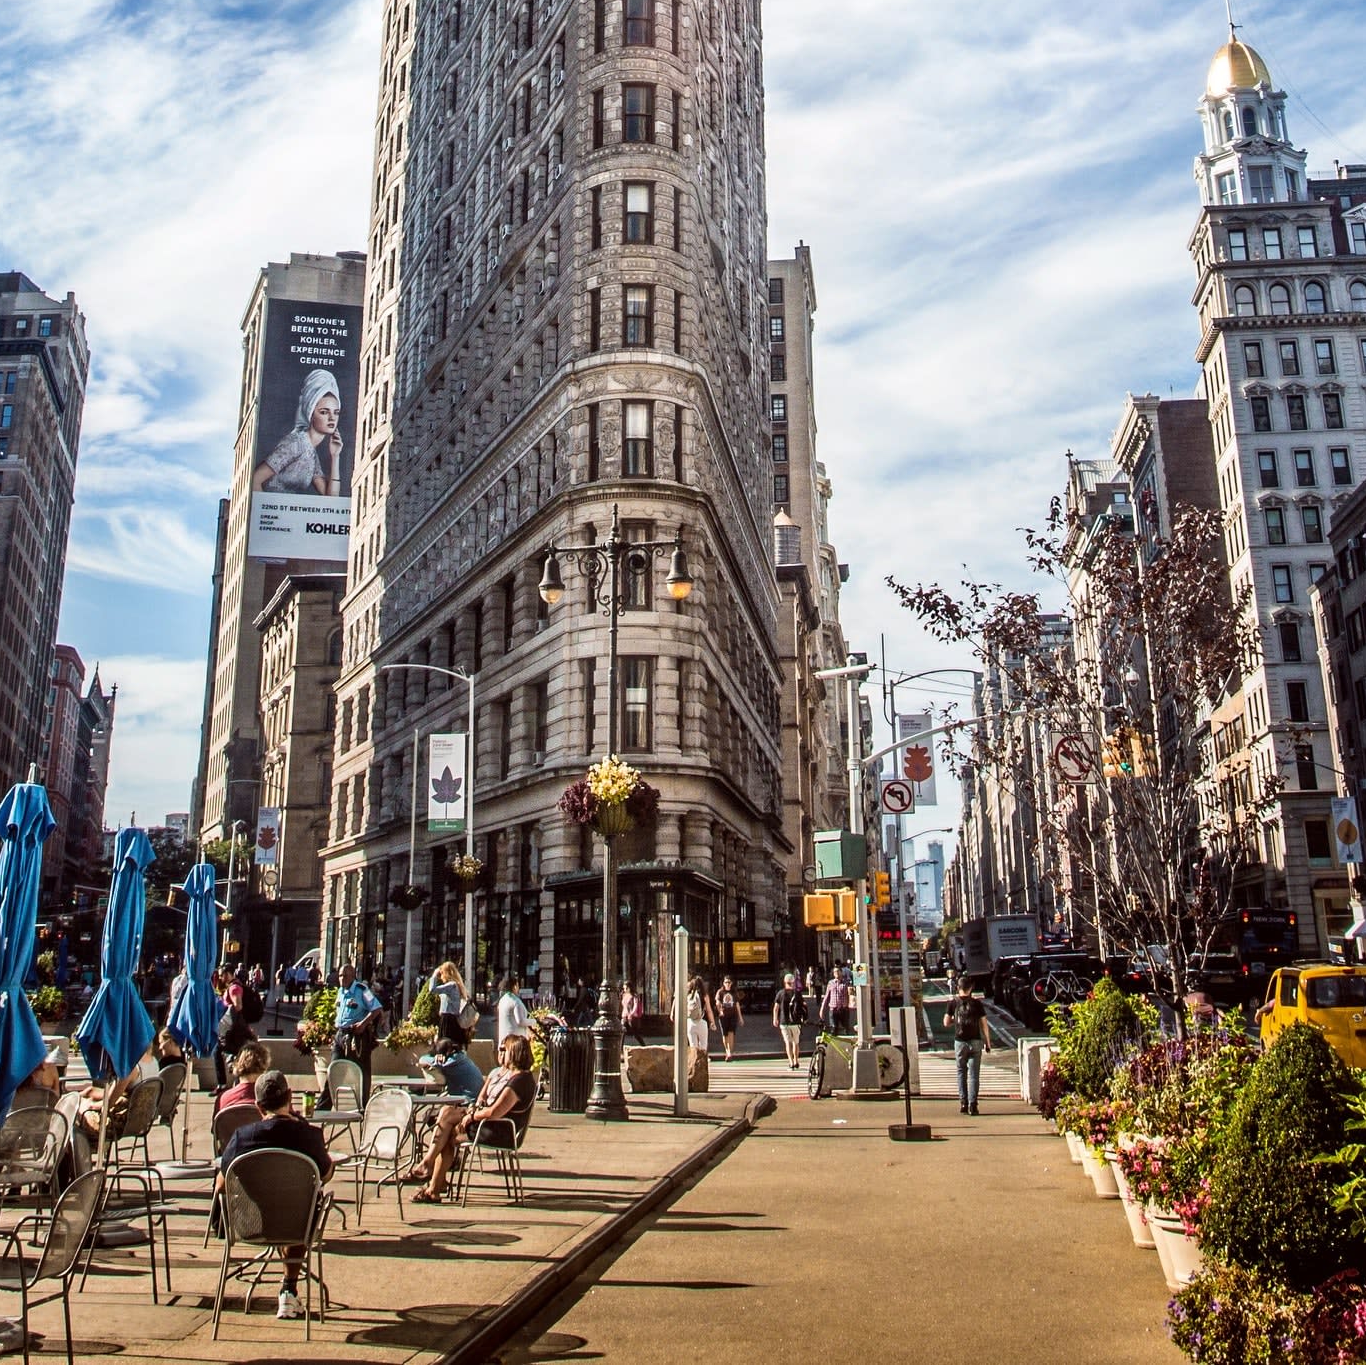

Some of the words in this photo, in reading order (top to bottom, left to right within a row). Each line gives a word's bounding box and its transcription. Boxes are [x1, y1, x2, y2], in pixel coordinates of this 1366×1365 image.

[294, 315, 346, 326] SOMEONE'S
[291, 325, 314, 334] BEEN
[317, 327, 329, 335] TO
[331, 328, 348, 337] THE
[290, 345, 346, 357] EXPERIENCE
[299, 356, 335, 366] CENTER
[261, 503, 278, 511] 22ND
[289, 505, 321, 513] BETWEEN
